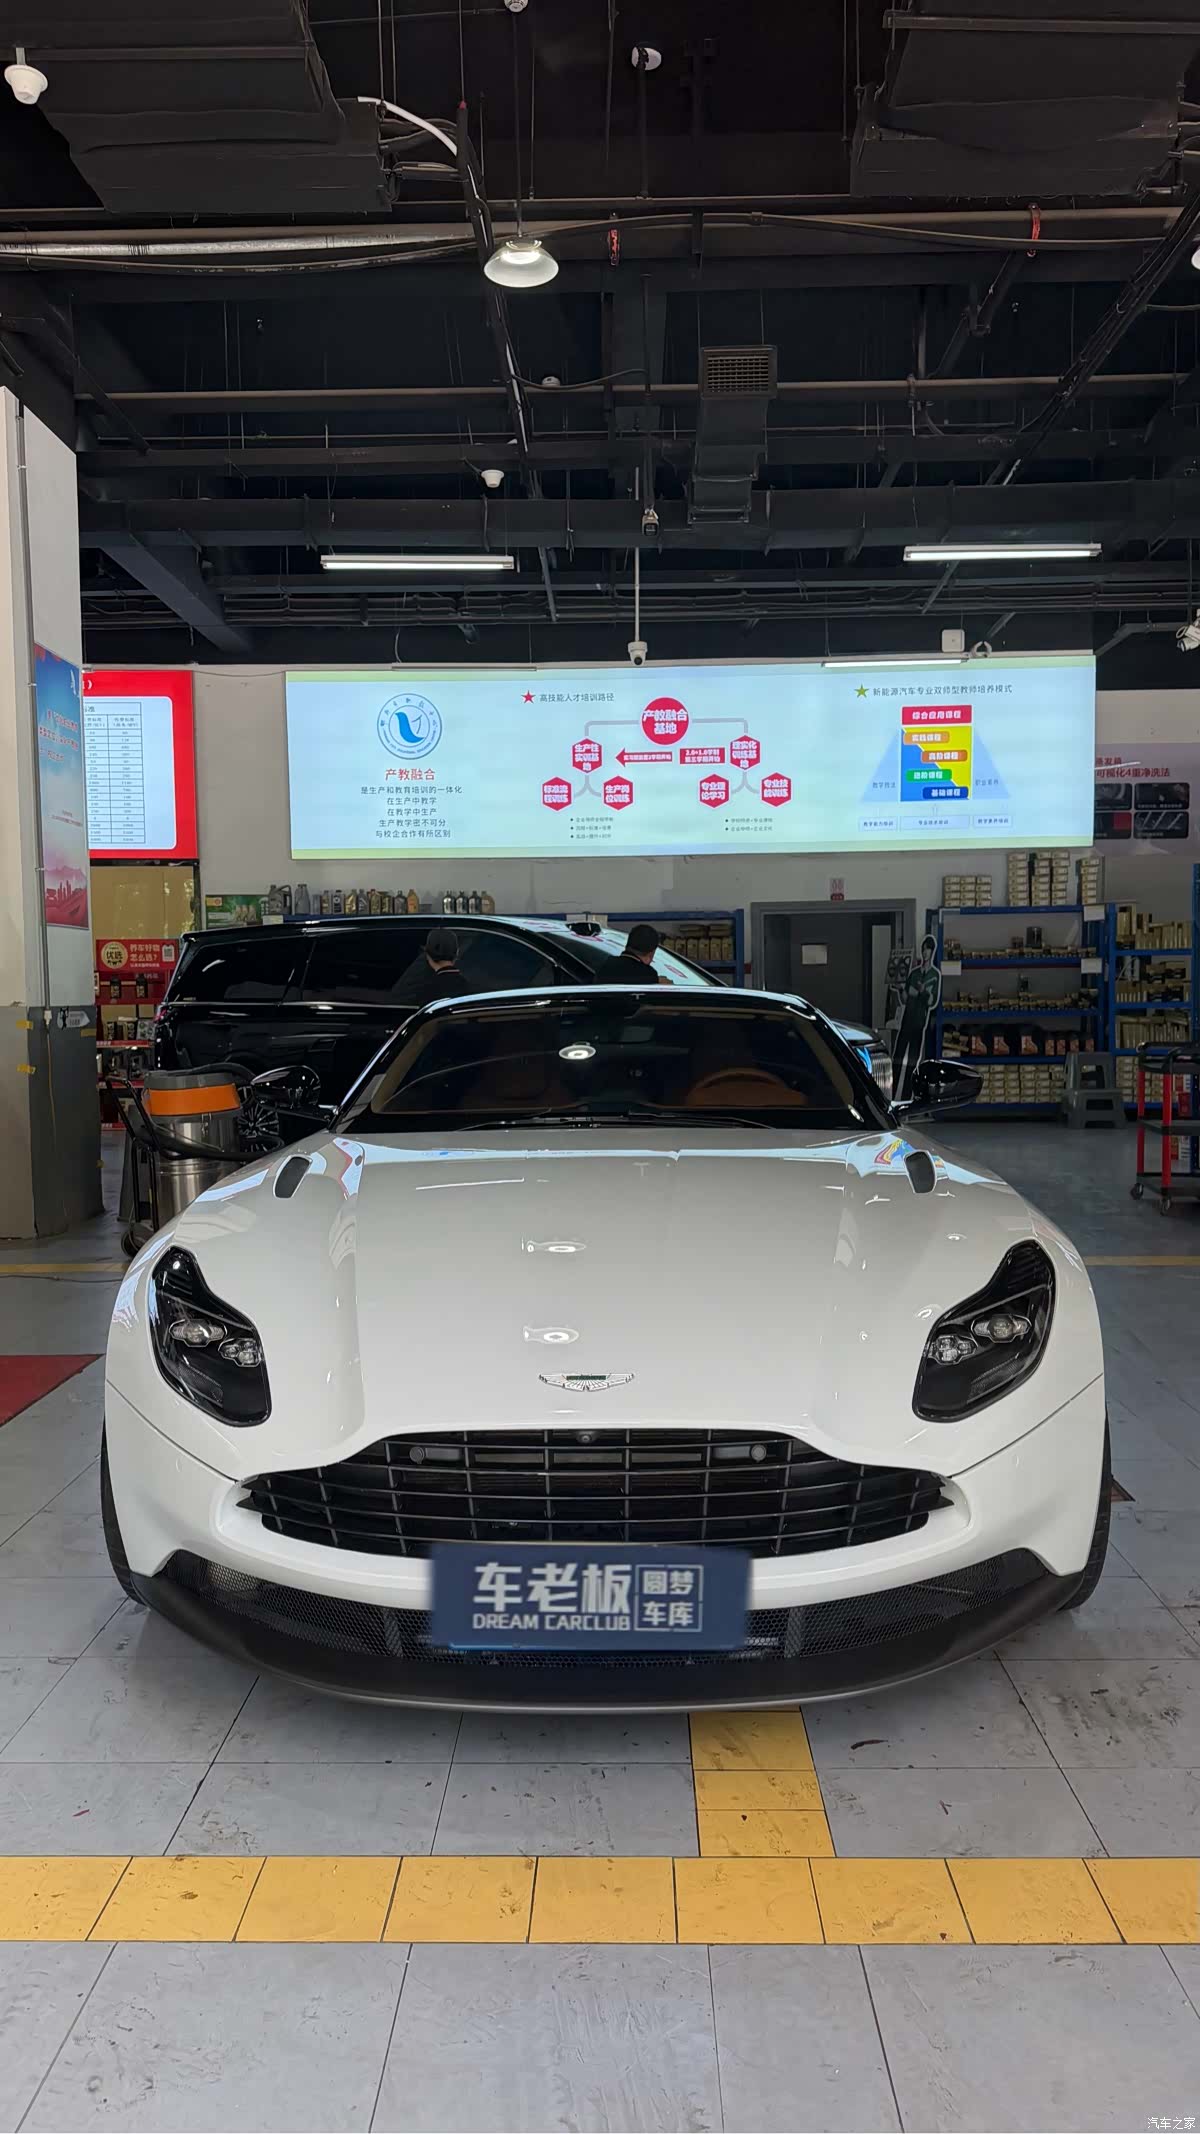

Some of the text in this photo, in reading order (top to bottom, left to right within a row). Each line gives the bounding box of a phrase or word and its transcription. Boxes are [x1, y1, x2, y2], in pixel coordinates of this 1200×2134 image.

[873, 684, 1013, 697] 新能源汽车专业双师型教师培养模式
[539, 692, 615, 702] 高技能人才培训路径
[642, 708, 688, 722] 产教融合
[912, 710, 961, 720] 综合应用课程
[654, 722, 677, 735] 基地
[385, 768, 436, 781] 产教融合
[361, 786, 463, 795] 是生产和教育培训的一体化
[387, 797, 437, 806] 在生产中教学
[387, 808, 437, 816] 在教学中生产
[379, 818, 446, 827] 生产教学密不可分
[376, 829, 451, 838] 与校企合作有所区别
[106, 951, 123, 960] 优选
